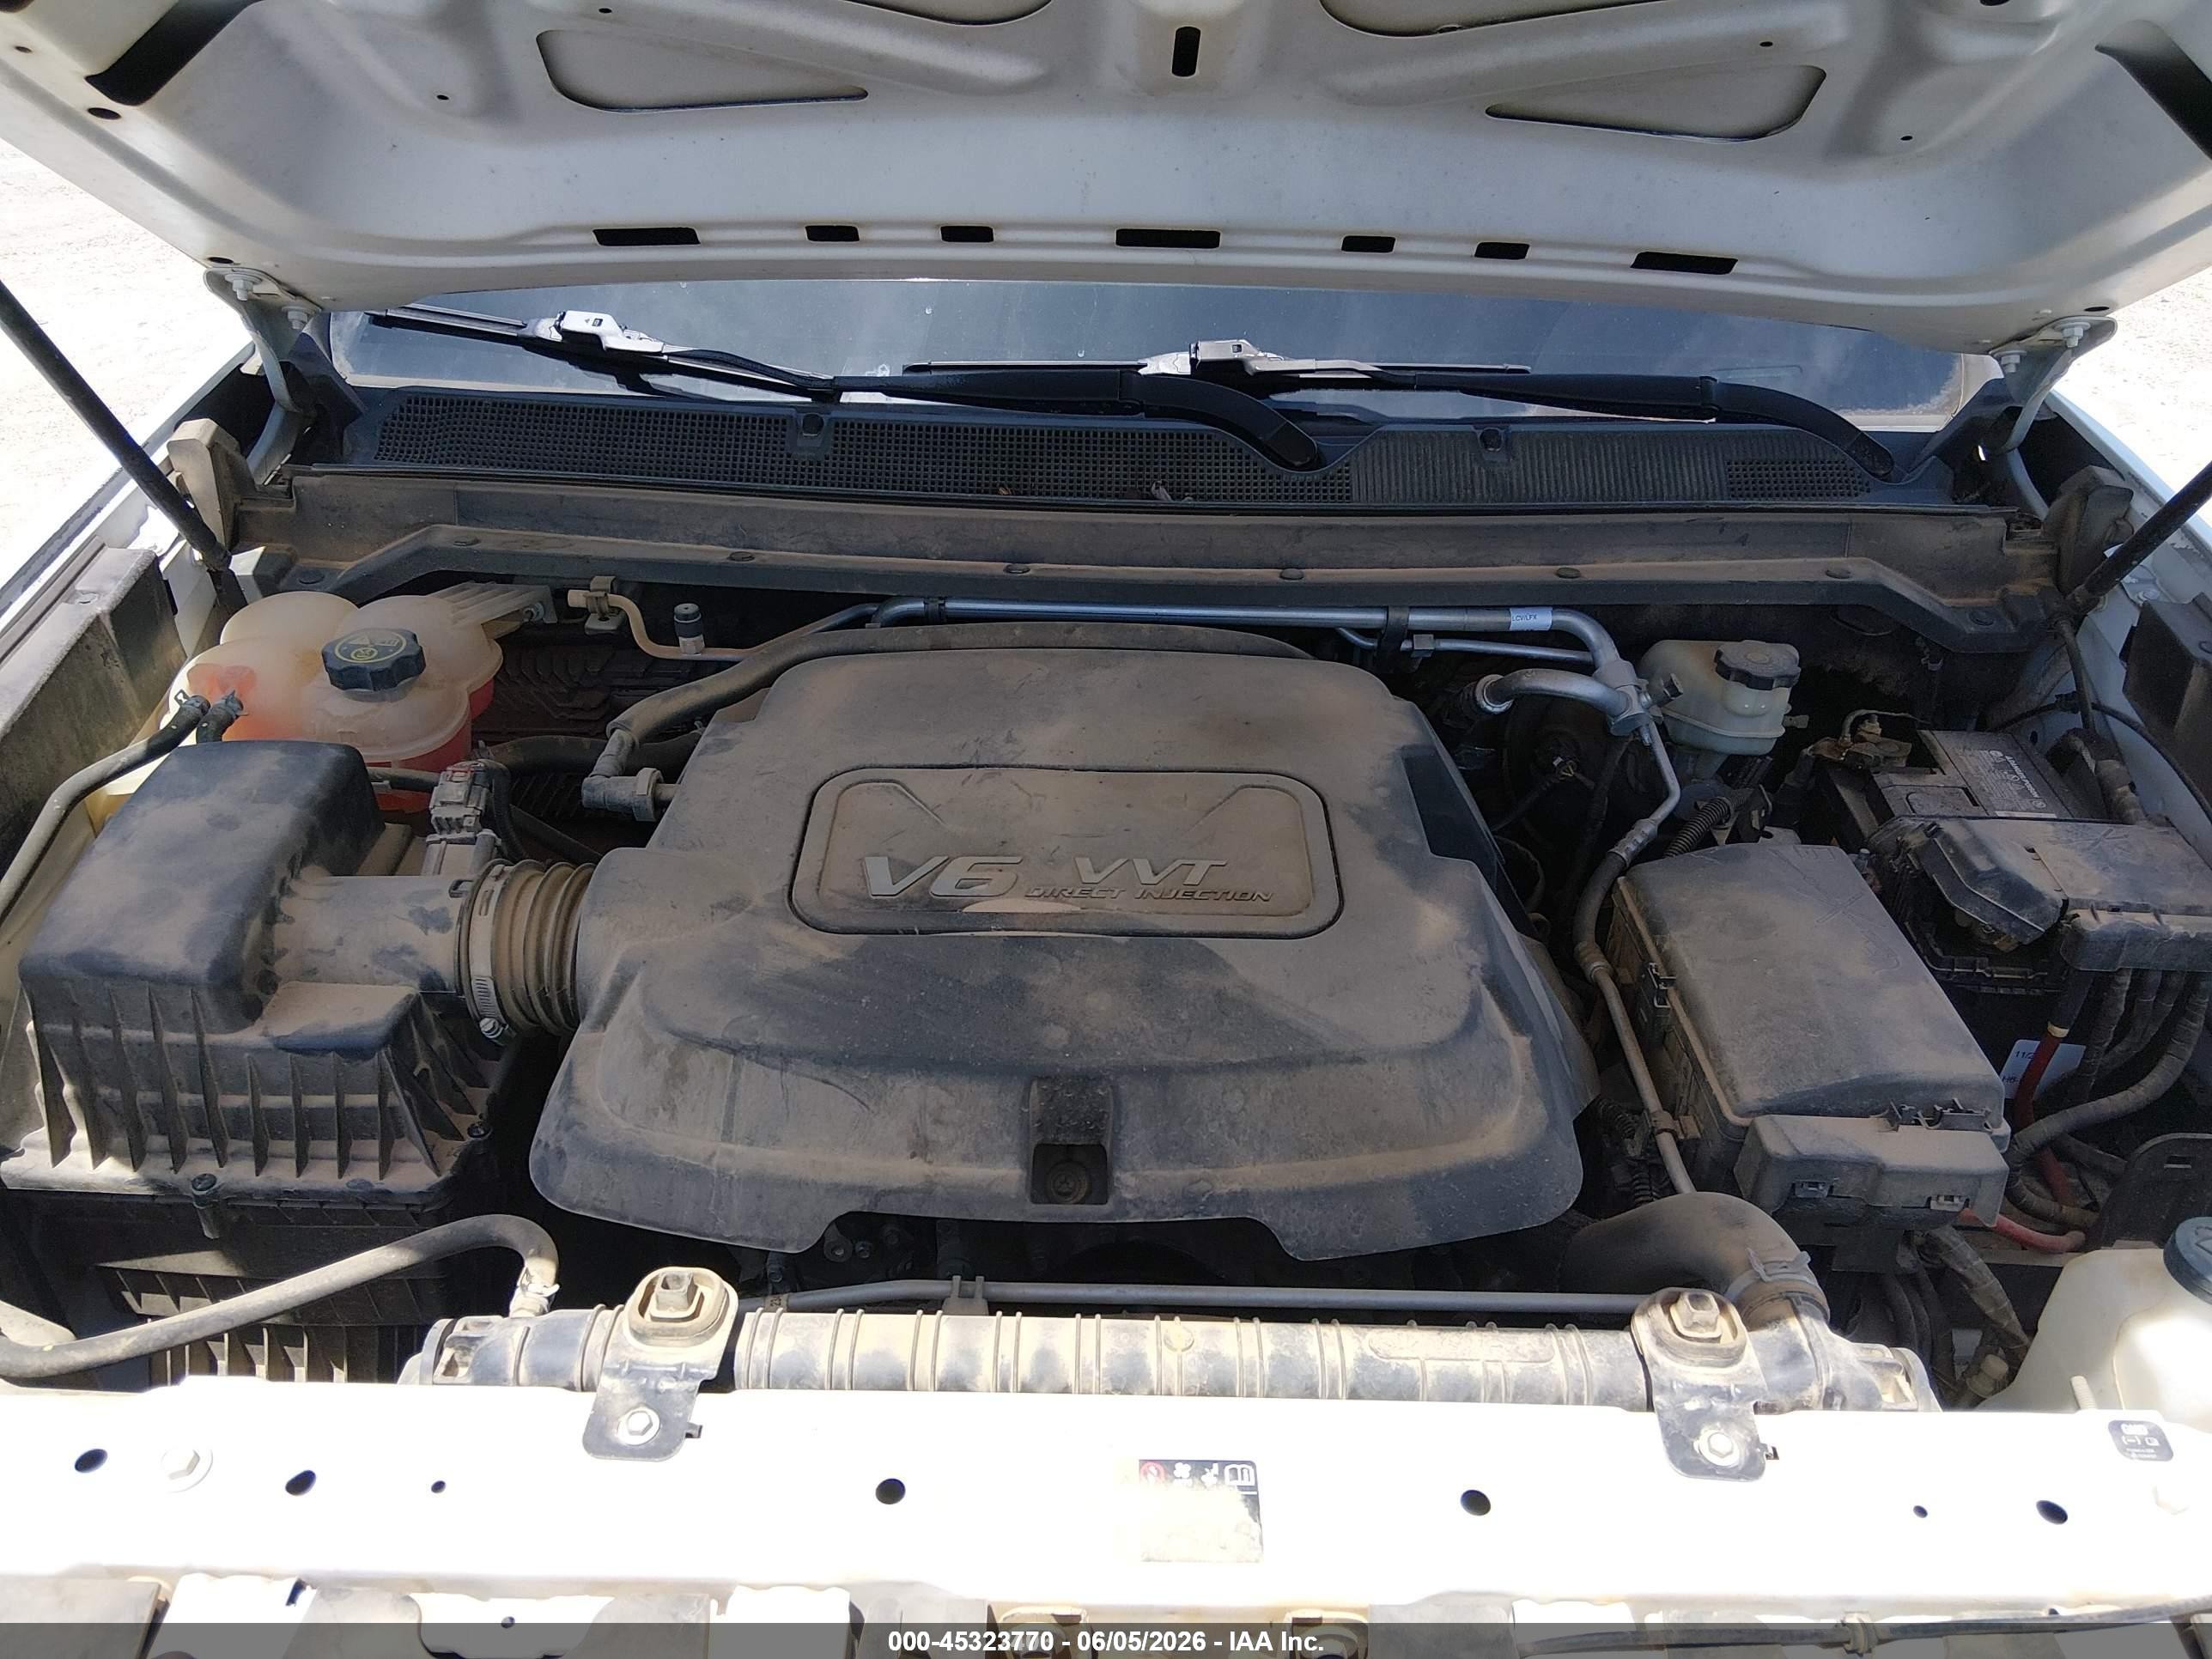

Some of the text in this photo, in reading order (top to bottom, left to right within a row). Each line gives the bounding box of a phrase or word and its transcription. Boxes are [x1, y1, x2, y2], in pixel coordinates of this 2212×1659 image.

[864, 856, 1228, 898] V6 VVT
[1024, 887, 1273, 902] DIRECT INJECTION
